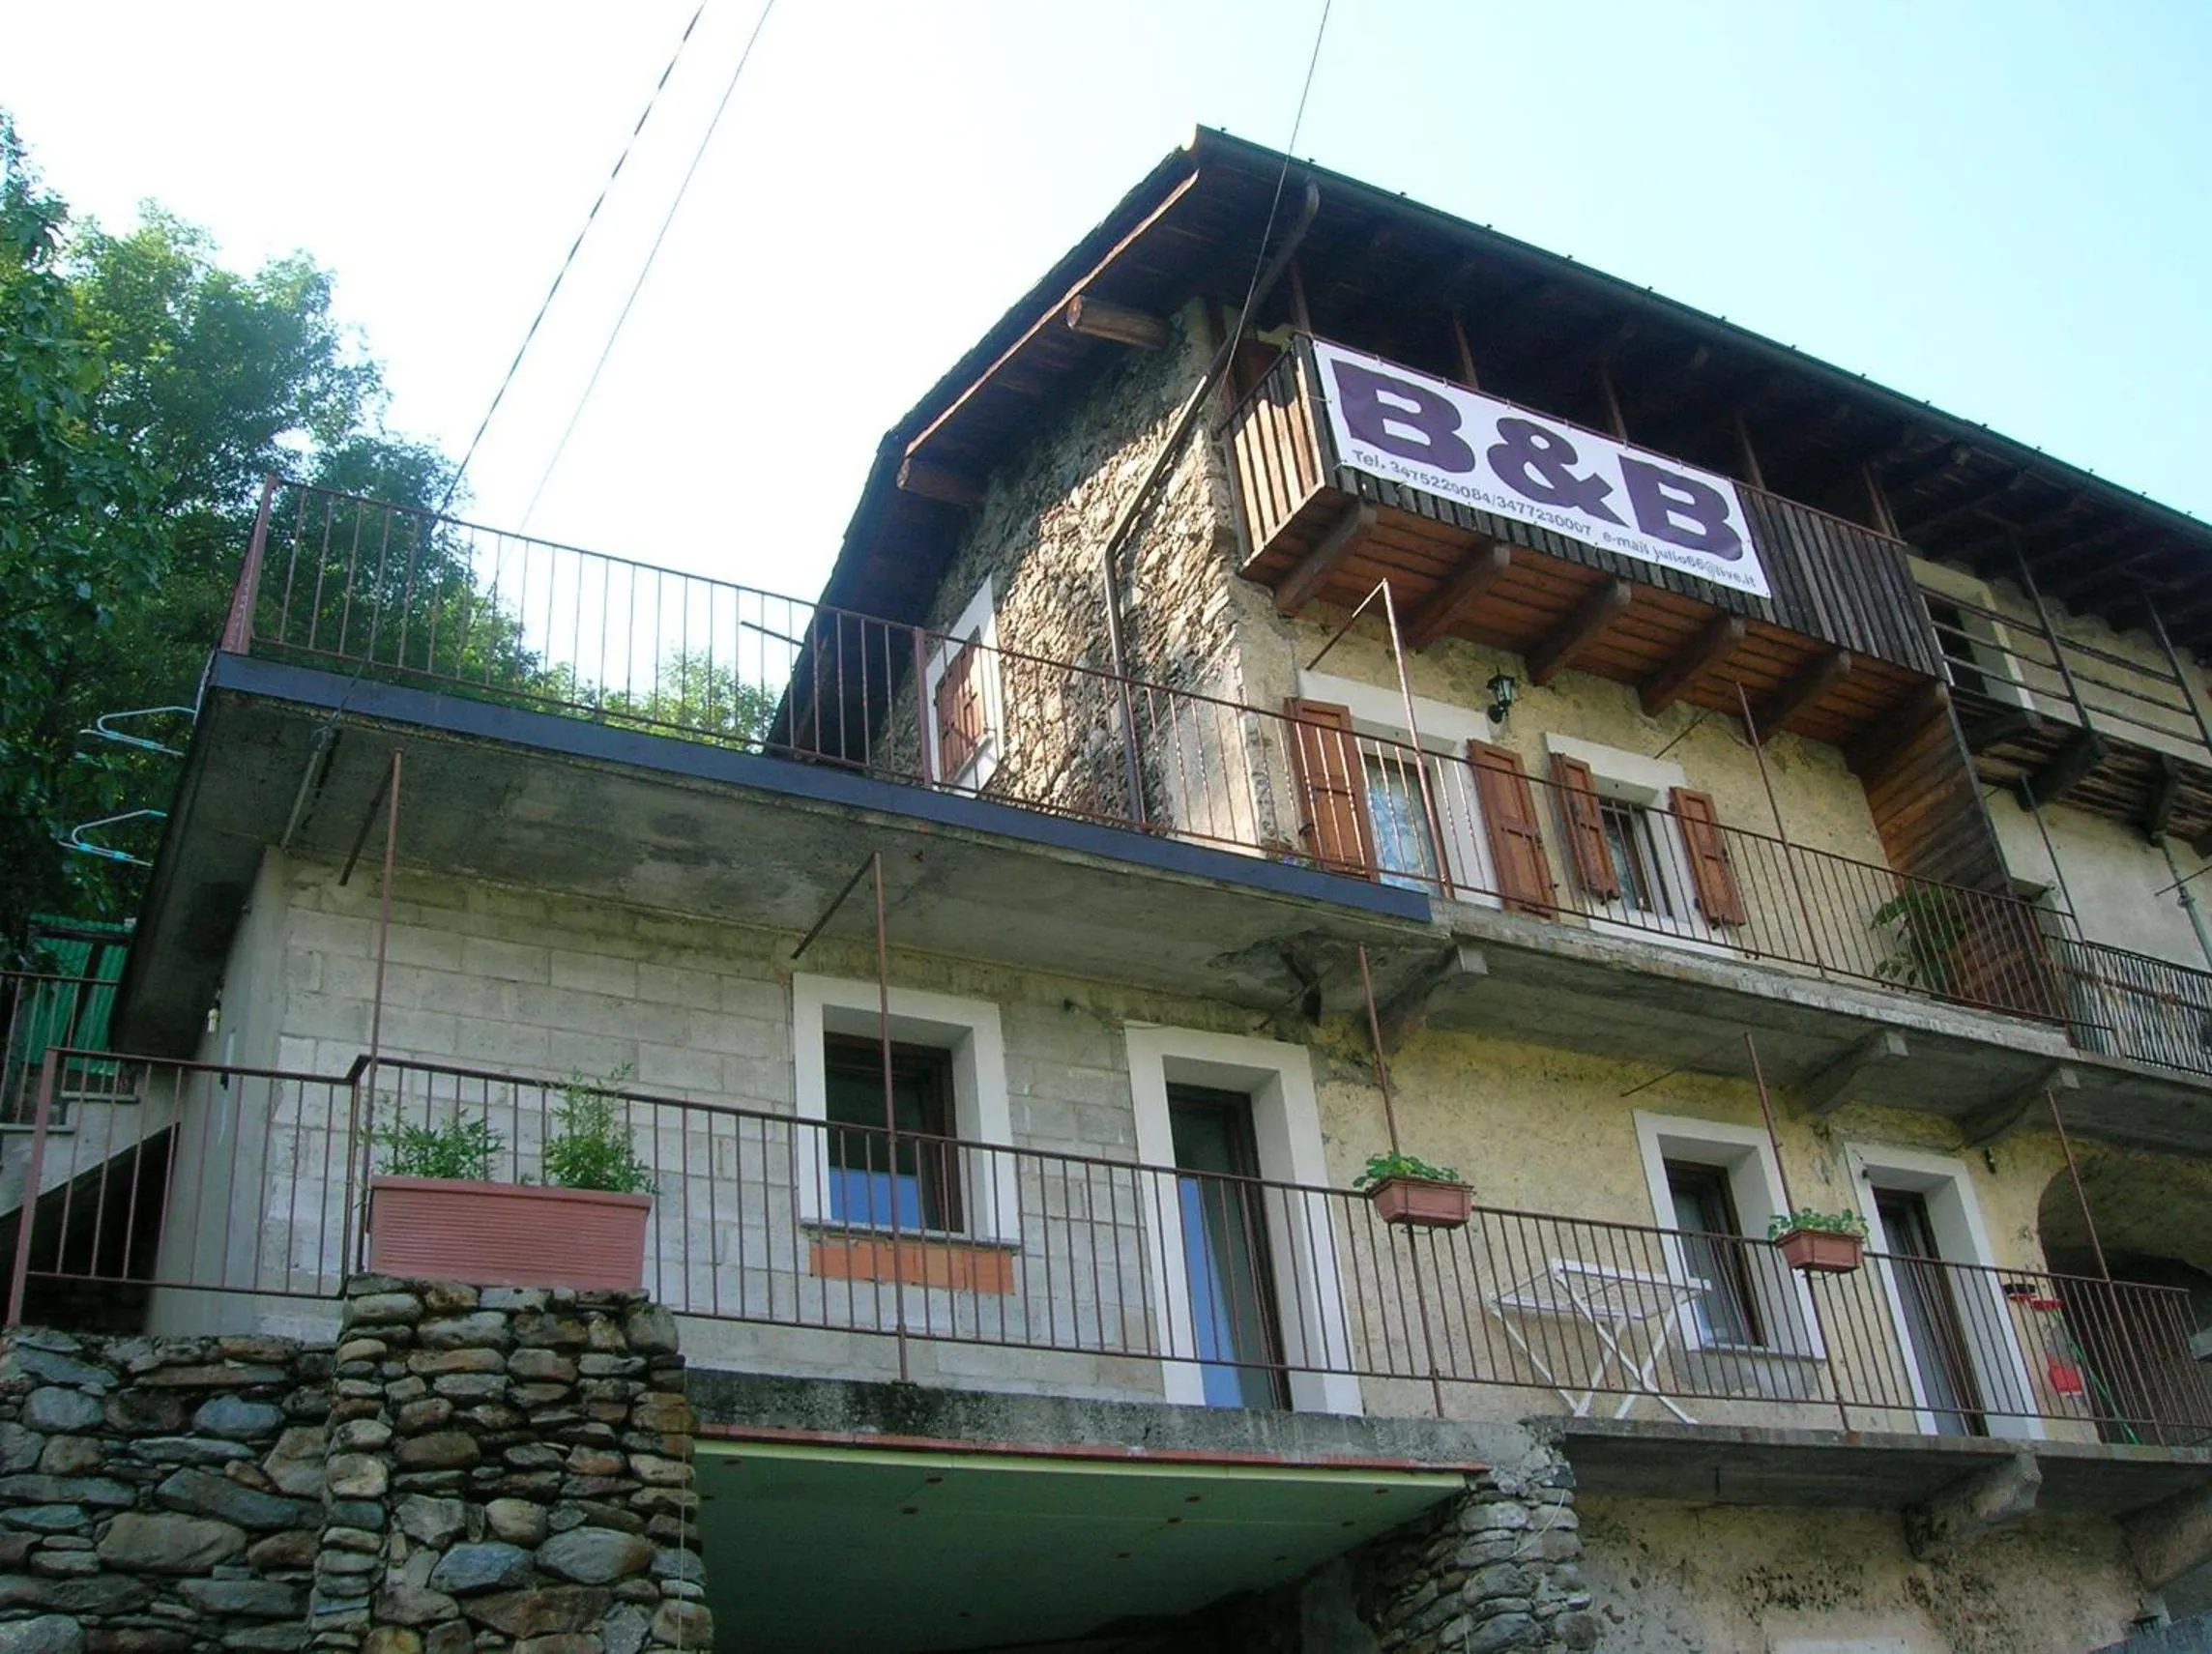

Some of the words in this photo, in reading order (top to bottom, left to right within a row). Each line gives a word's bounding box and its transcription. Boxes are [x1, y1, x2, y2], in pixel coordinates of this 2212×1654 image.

[1330, 358, 1744, 561] B&B
[1352, 450, 1385, 470] Tel.
[1602, 531, 1649, 556] e-mail
